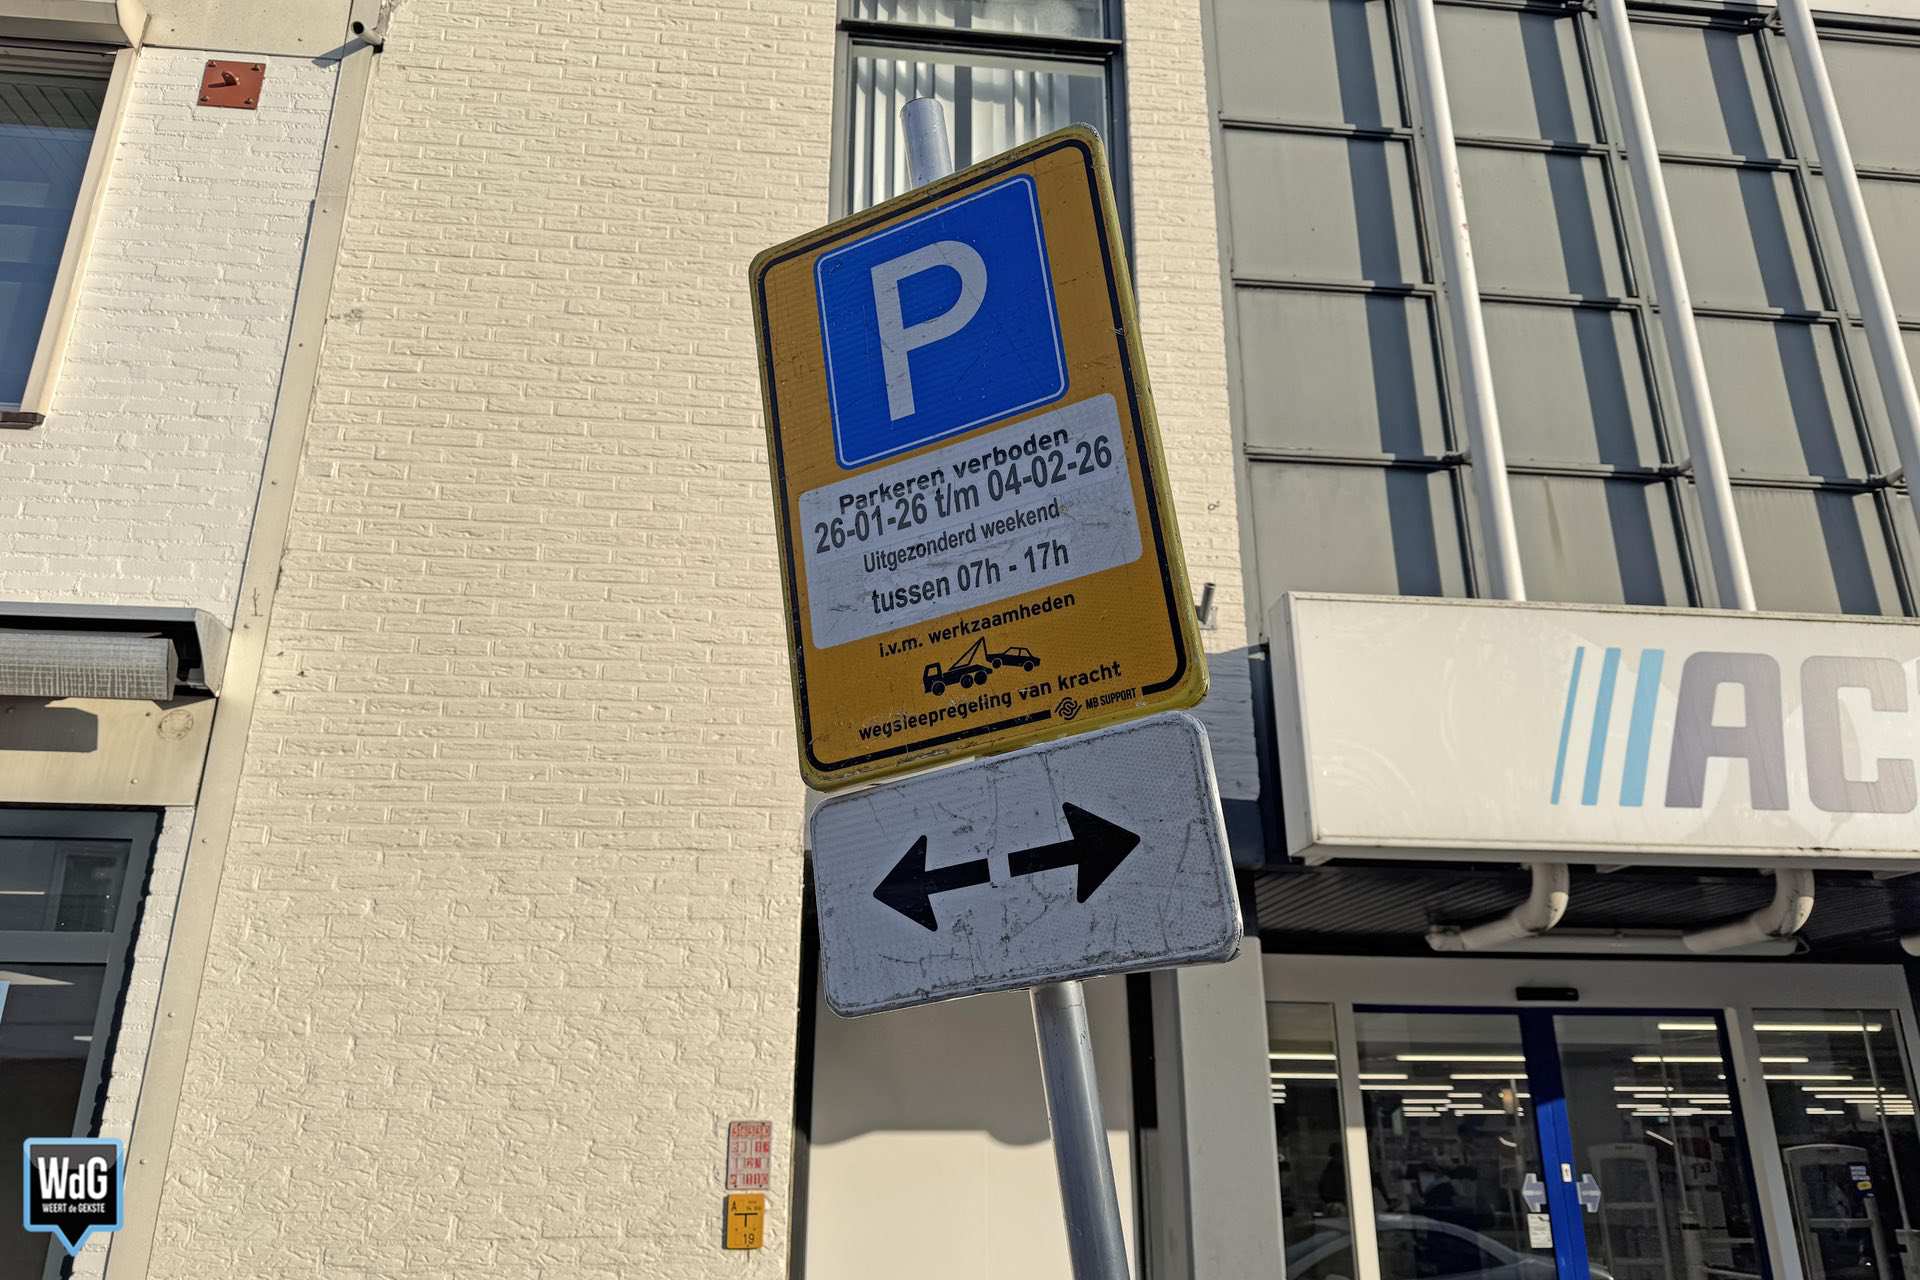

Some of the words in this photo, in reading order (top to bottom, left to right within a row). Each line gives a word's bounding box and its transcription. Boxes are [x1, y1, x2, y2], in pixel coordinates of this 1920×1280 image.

[870, 240, 988, 422] P
[815, 493, 928, 554] 26-01-26
[935, 481, 980, 519] t/m
[988, 435, 1112, 501] 04-02-26
[839, 466, 945, 515] Parkeren
[953, 427, 1069, 479] verboden
[863, 524, 977, 573] Uitgezonderd
[981, 498, 1060, 540] weekend
[871, 577, 950, 614] tussen
[957, 558, 1000, 591] 07h
[1024, 539, 1069, 574] 17h
[879, 636, 923, 657] i.v.m.
[928, 592, 1075, 645] werkzaamheden
[859, 689, 1012, 742] wegsleepregeling
[1019, 681, 1051, 701] van
[1058, 660, 1122, 691] kracht
[1086, 696, 1100, 710] MB
[1100, 687, 1137, 708] SUPPORT
[1664, 651, 1920, 814] AC
